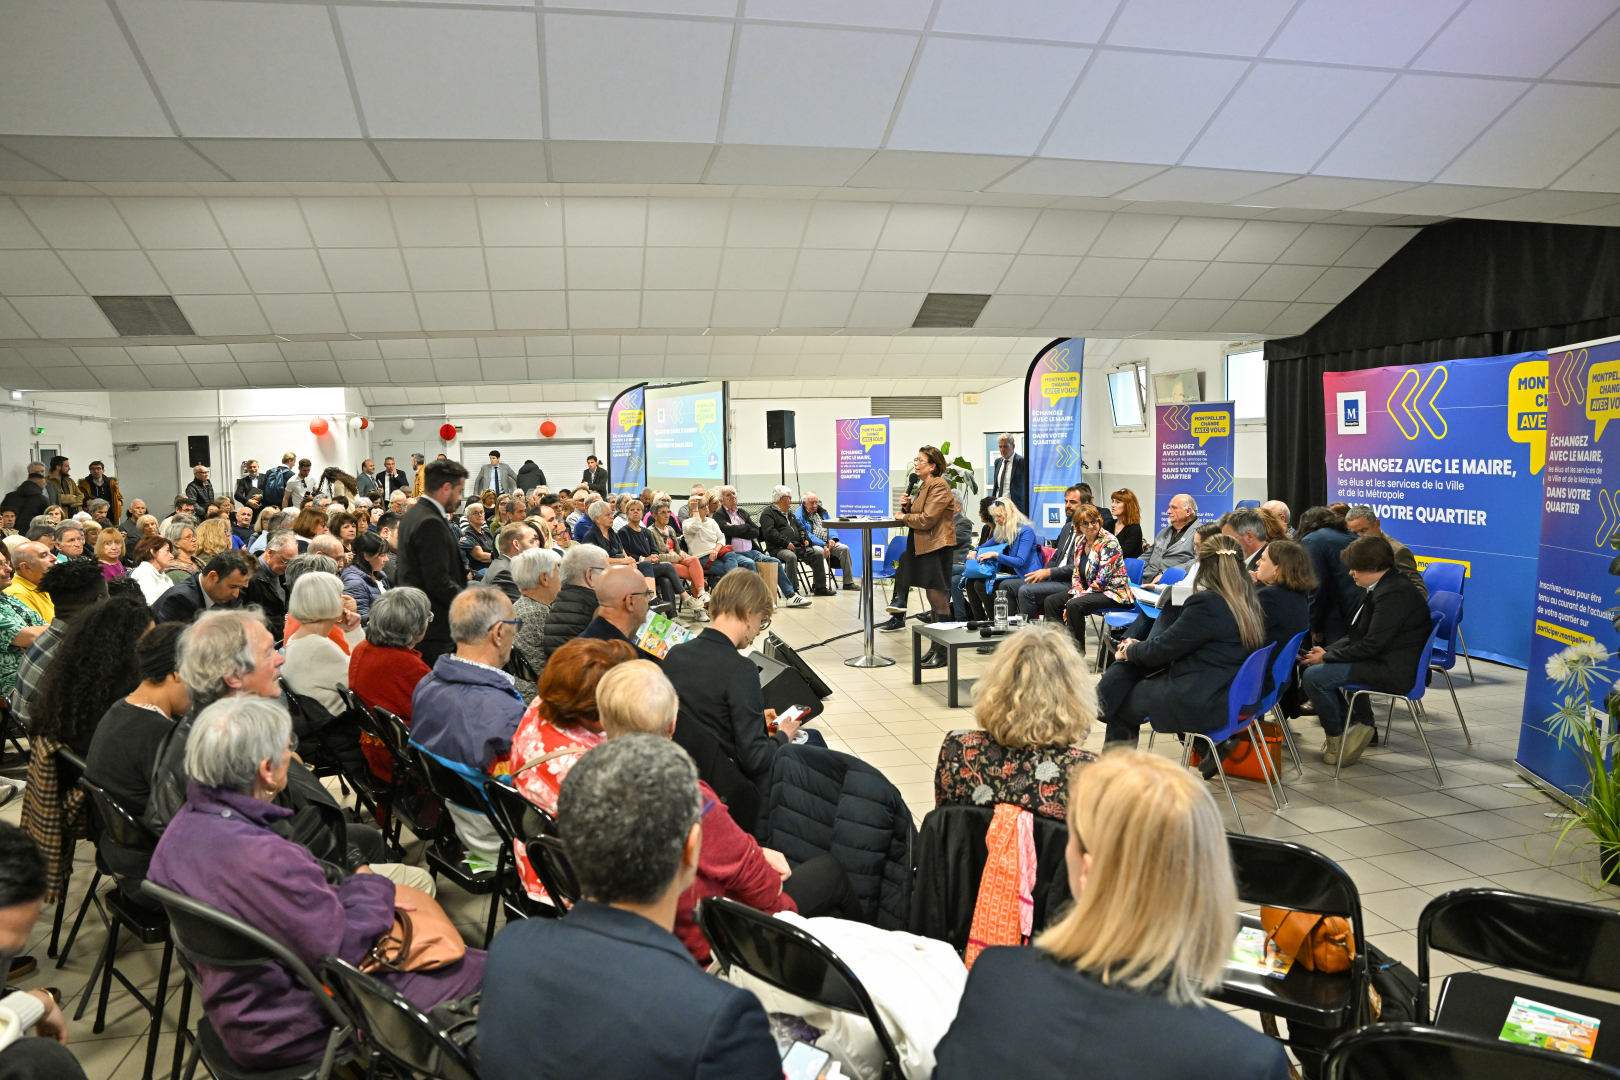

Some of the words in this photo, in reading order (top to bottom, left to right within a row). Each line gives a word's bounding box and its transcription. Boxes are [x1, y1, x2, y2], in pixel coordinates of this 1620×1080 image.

[1592, 399, 1608, 410] AVEC
[1347, 408, 1356, 419] M
[1550, 433, 1588, 447] ÉCHANGEZ
[1549, 450, 1568, 461] AVEC
[1569, 451, 1576, 462] LE
[1577, 451, 1603, 463] MAIRE,
[1338, 454, 1403, 472] ÉCHANGEZ
[1405, 458, 1442, 474] AVEC
[1445, 459, 1459, 474] LE
[1462, 459, 1517, 478] MAIRE,
[1338, 478, 1348, 486] les
[1349, 478, 1364, 487] élus
[1365, 479, 1373, 487] et
[1374, 479, 1386, 488] les
[1387, 479, 1420, 489] services
[1422, 480, 1433, 489] de
[1435, 480, 1443, 490] la
[1445, 481, 1464, 491] Ville
[1578, 476, 1602, 486] Métropole
[1346, 488, 1355, 497] de
[1357, 489, 1364, 497] la
[1365, 489, 1405, 501] Métropole
[1546, 487, 1566, 499] DANS
[1567, 488, 1591, 500] VOTRE
[1546, 500, 1580, 515] QUARTIER
[1372, 504, 1414, 520] VOTRE
[1415, 506, 1487, 526] QUARTIER
[1539, 580, 1576, 597] Inscrivez-vous
[1576, 590, 1590, 600] pour
[1590, 592, 1602, 603] être
[1538, 593, 1550, 602] tenu
[1558, 599, 1579, 610] courant
[1579, 604, 1586, 613] de
[1537, 605, 1544, 614] de
[1545, 608, 1557, 618] votre
[1558, 612, 1579, 624] quartier
